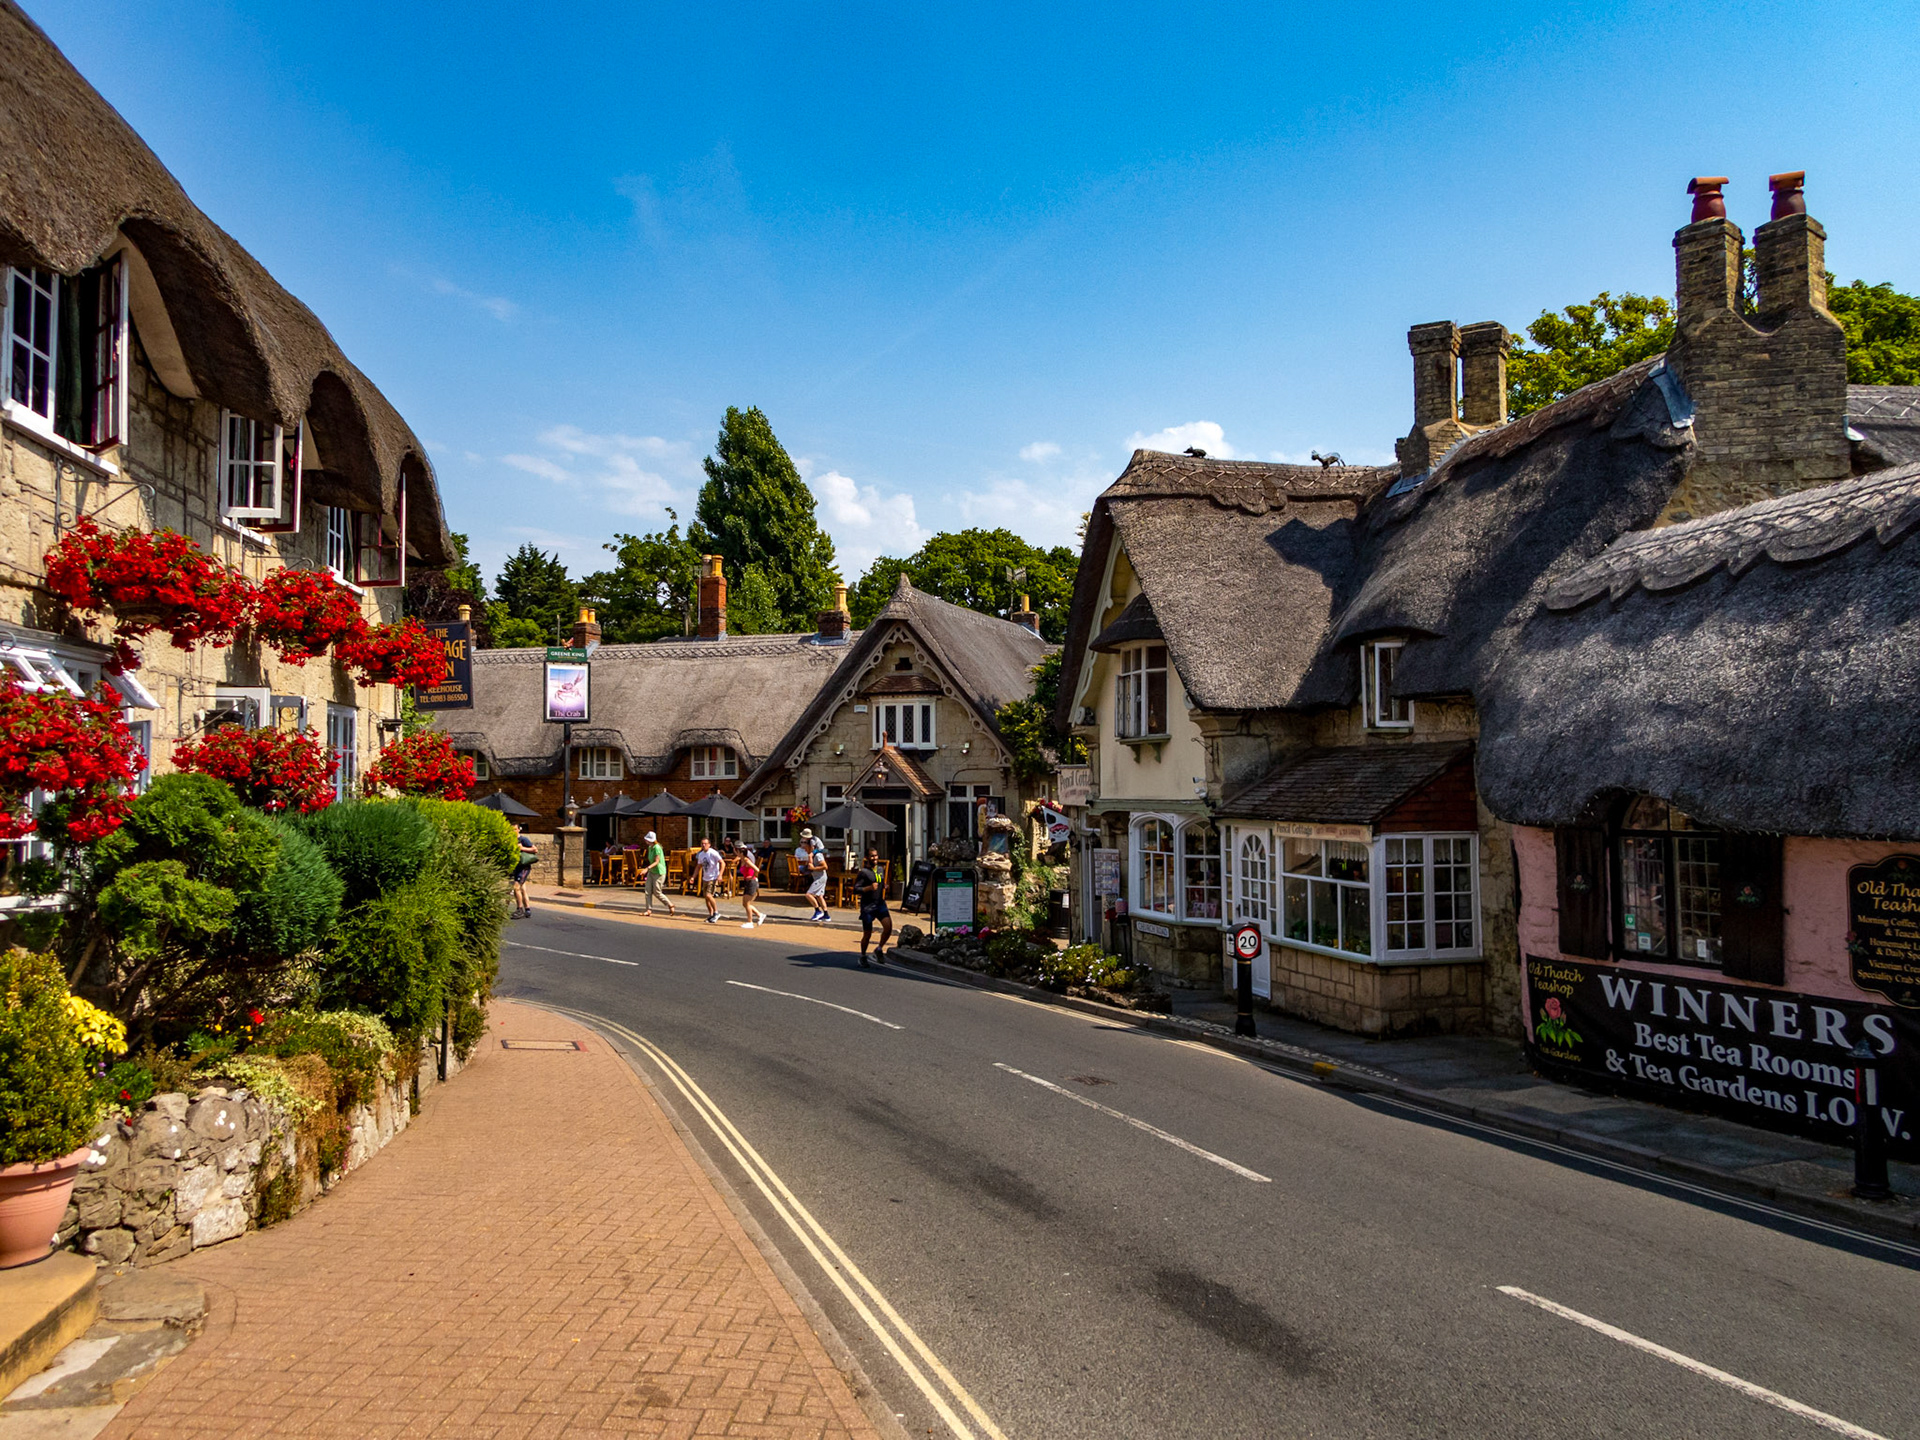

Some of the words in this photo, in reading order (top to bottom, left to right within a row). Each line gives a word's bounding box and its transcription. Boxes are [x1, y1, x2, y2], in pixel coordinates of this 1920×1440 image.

[434, 628, 448, 638] THE
[1857, 880, 1889, 896] Old
[1872, 896, 1920, 913] Teash
[1857, 915, 1889, 927] Morning
[1884, 928, 1893, 937] &
[1240, 935, 1257, 948] 20
[1869, 937, 1912, 950] Homemade
[1876, 947, 1883, 956] &
[1885, 948, 1906, 960] Daily
[1544, 965, 1585, 982] Thatch
[1534, 976, 1574, 999] Teashop
[1597, 974, 1896, 1055] WINNERS
[1634, 1021, 1691, 1056] Best
[1694, 1032, 1743, 1067] Tea
[1749, 1043, 1856, 1090] Rooms
[1605, 1048, 1628, 1075] &
[1629, 1052, 1675, 1084] Tea
[1678, 1065, 1798, 1114] Gardens
